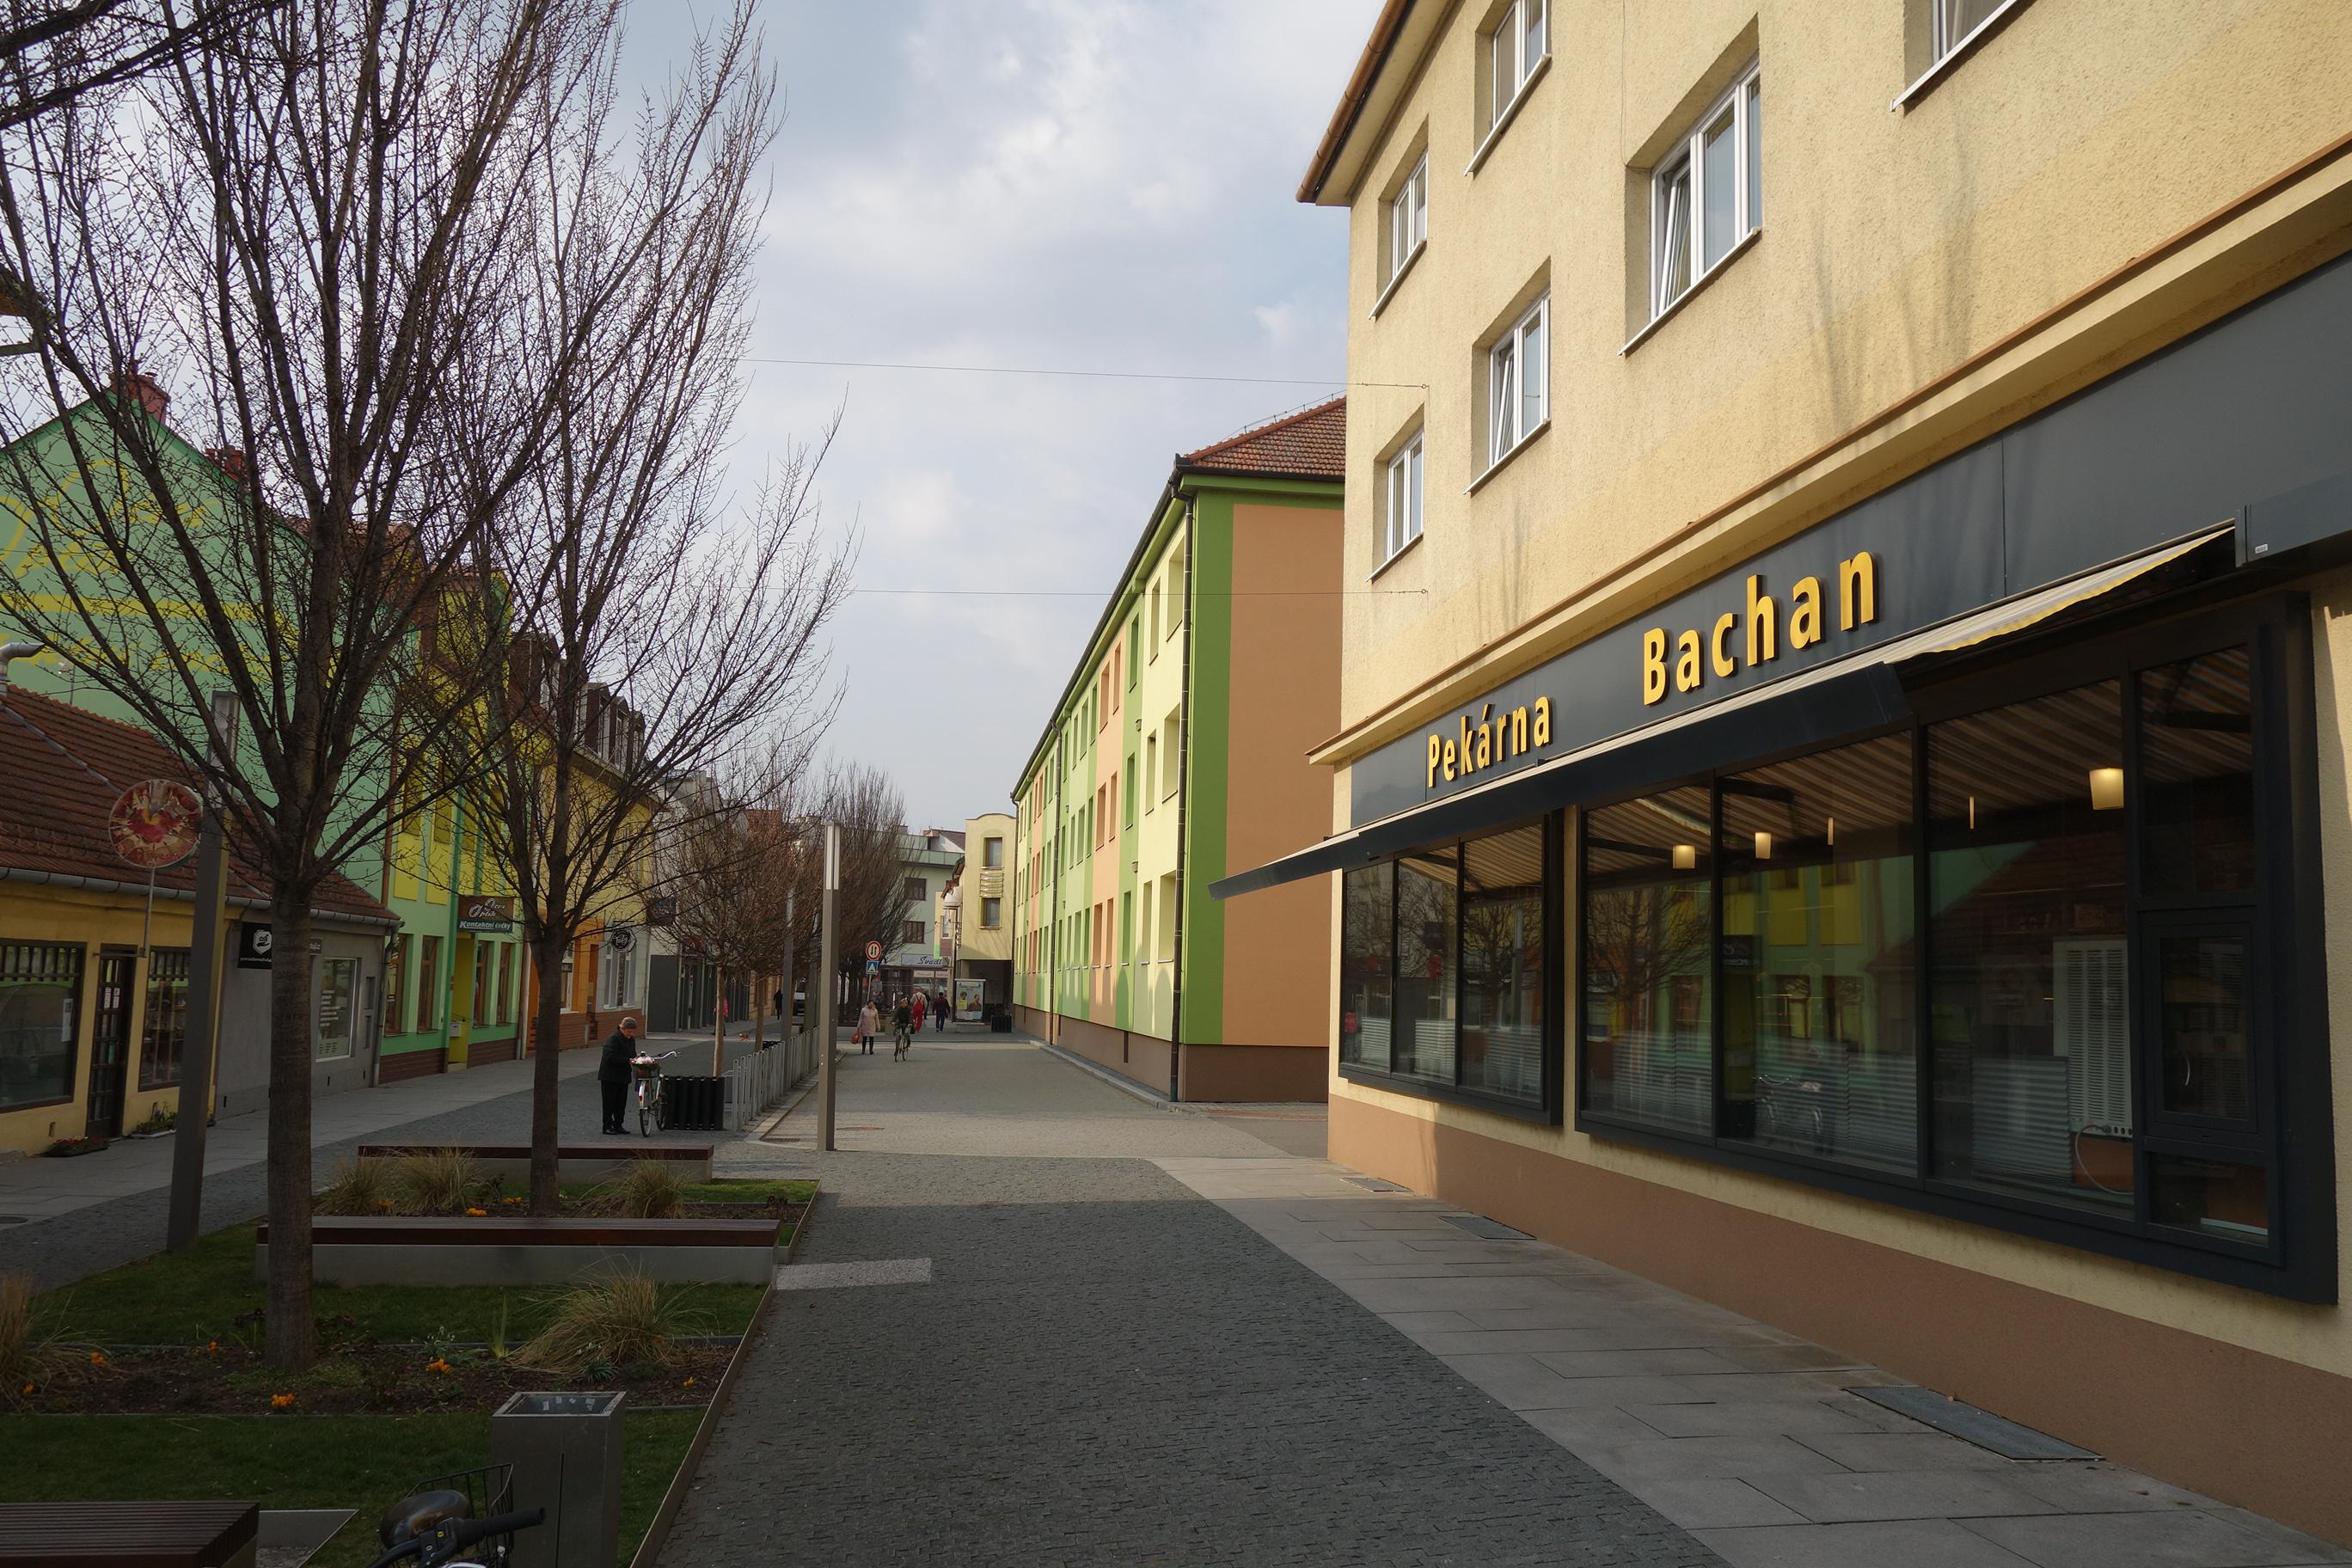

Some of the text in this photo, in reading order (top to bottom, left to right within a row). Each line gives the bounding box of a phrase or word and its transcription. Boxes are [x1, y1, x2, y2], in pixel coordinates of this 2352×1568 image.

[1428, 550, 1877, 787] Pekárna Bachan
[459, 921, 495, 929] Kontaktní
